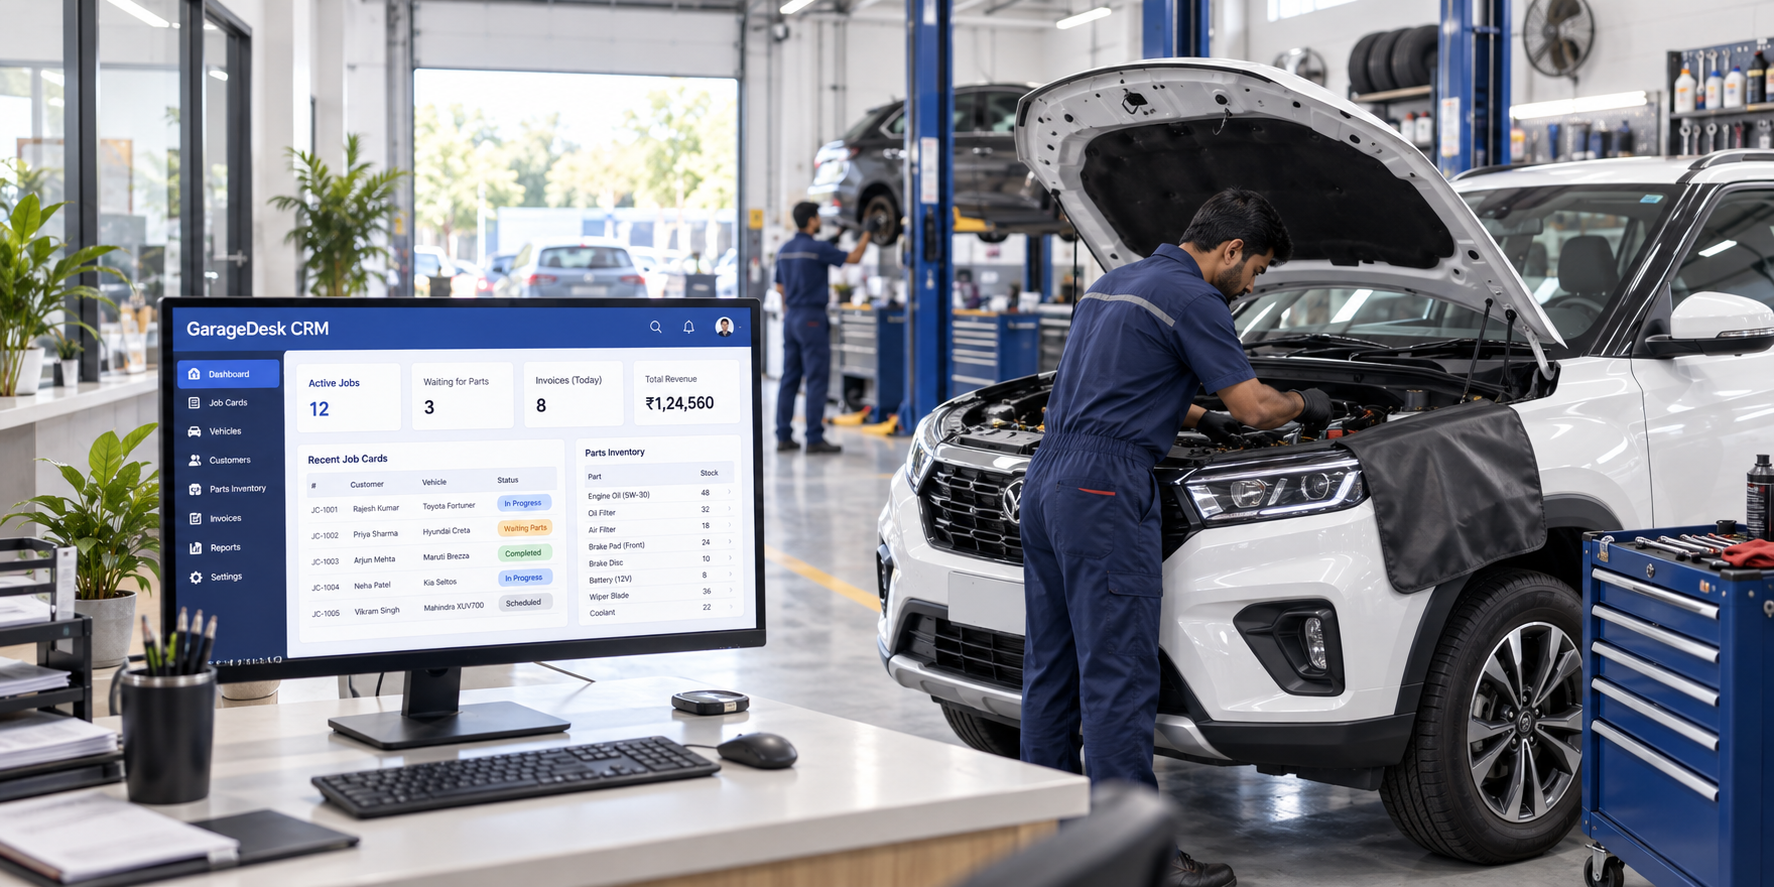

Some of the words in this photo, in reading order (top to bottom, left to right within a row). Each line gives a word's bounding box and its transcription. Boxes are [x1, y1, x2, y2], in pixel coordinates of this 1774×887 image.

[186, 321, 286, 340] GarageDesk
[290, 322, 329, 336] CRM
[209, 370, 250, 378] Dashboard
[308, 379, 336, 388] Active
[338, 378, 360, 387] Jobs
[424, 378, 454, 387] Waiting
[456, 377, 466, 385] for
[468, 377, 489, 386] Parts
[536, 376, 570, 385] Invoices
[571, 375, 602, 386] (Today)
[665, 375, 697, 383] Revenue
[209, 399, 224, 407] Job
[225, 398, 248, 406] Cards
[424, 400, 435, 414] 3
[536, 398, 546, 412] 8
[645, 396, 714, 412] ₹1,24,560
[309, 401, 330, 416] 12
[210, 427, 242, 436] Vehicles
[585, 448, 606, 457] Parts
[608, 447, 645, 457] Inventory
[209, 456, 251, 464] Customers
[308, 455, 340, 464] Recent
[342, 455, 359, 464] Job
[362, 454, 388, 463] Cards
[700, 469, 718, 477] Stock
[350, 480, 384, 488] Customer
[422, 478, 447, 486] Vehicle
[497, 476, 519, 484] Status
[210, 485, 230, 493] Parts
[232, 484, 266, 494] Inventory
[612, 492, 621, 500] Oil
[353, 504, 376, 514] Rajesh
[377, 504, 400, 512] Kumar
[423, 502, 446, 511] Toyota
[446, 501, 476, 509] Fortuner
[513, 500, 542, 510] Progress
[310, 506, 338, 514] JC-1001
[210, 514, 242, 522] Invoices
[423, 527, 451, 536] Hyundai
[531, 523, 548, 531] Parts
[310, 532, 339, 540] JC-1002
[354, 530, 371, 539] Priya
[372, 529, 398, 537] Sharma
[211, 543, 241, 553] Reports
[608, 542, 621, 550] Pad
[623, 541, 645, 550] (Front)
[423, 553, 446, 561] Maruti
[505, 549, 542, 558] Completed
[311, 558, 339, 566] JC-1003
[354, 556, 372, 565] Arjun
[374, 555, 396, 564] Mehta
[211, 572, 242, 582] Settings
[505, 574, 513, 582] In
[514, 574, 543, 584] Progress
[614, 575, 632, 584] (12V)
[374, 580, 391, 589] Patel
[424, 578, 436, 586] Kia
[436, 578, 457, 586] Seltos
[589, 593, 609, 602] Wiper
[424, 603, 455, 612] Mahindra
[457, 602, 485, 610] XUV700
[506, 598, 542, 607] Scheduled
[312, 609, 340, 618] JC-1005
[354, 607, 379, 616] Vikram
[380, 606, 400, 615] Singh
[590, 609, 616, 617] Coolant
